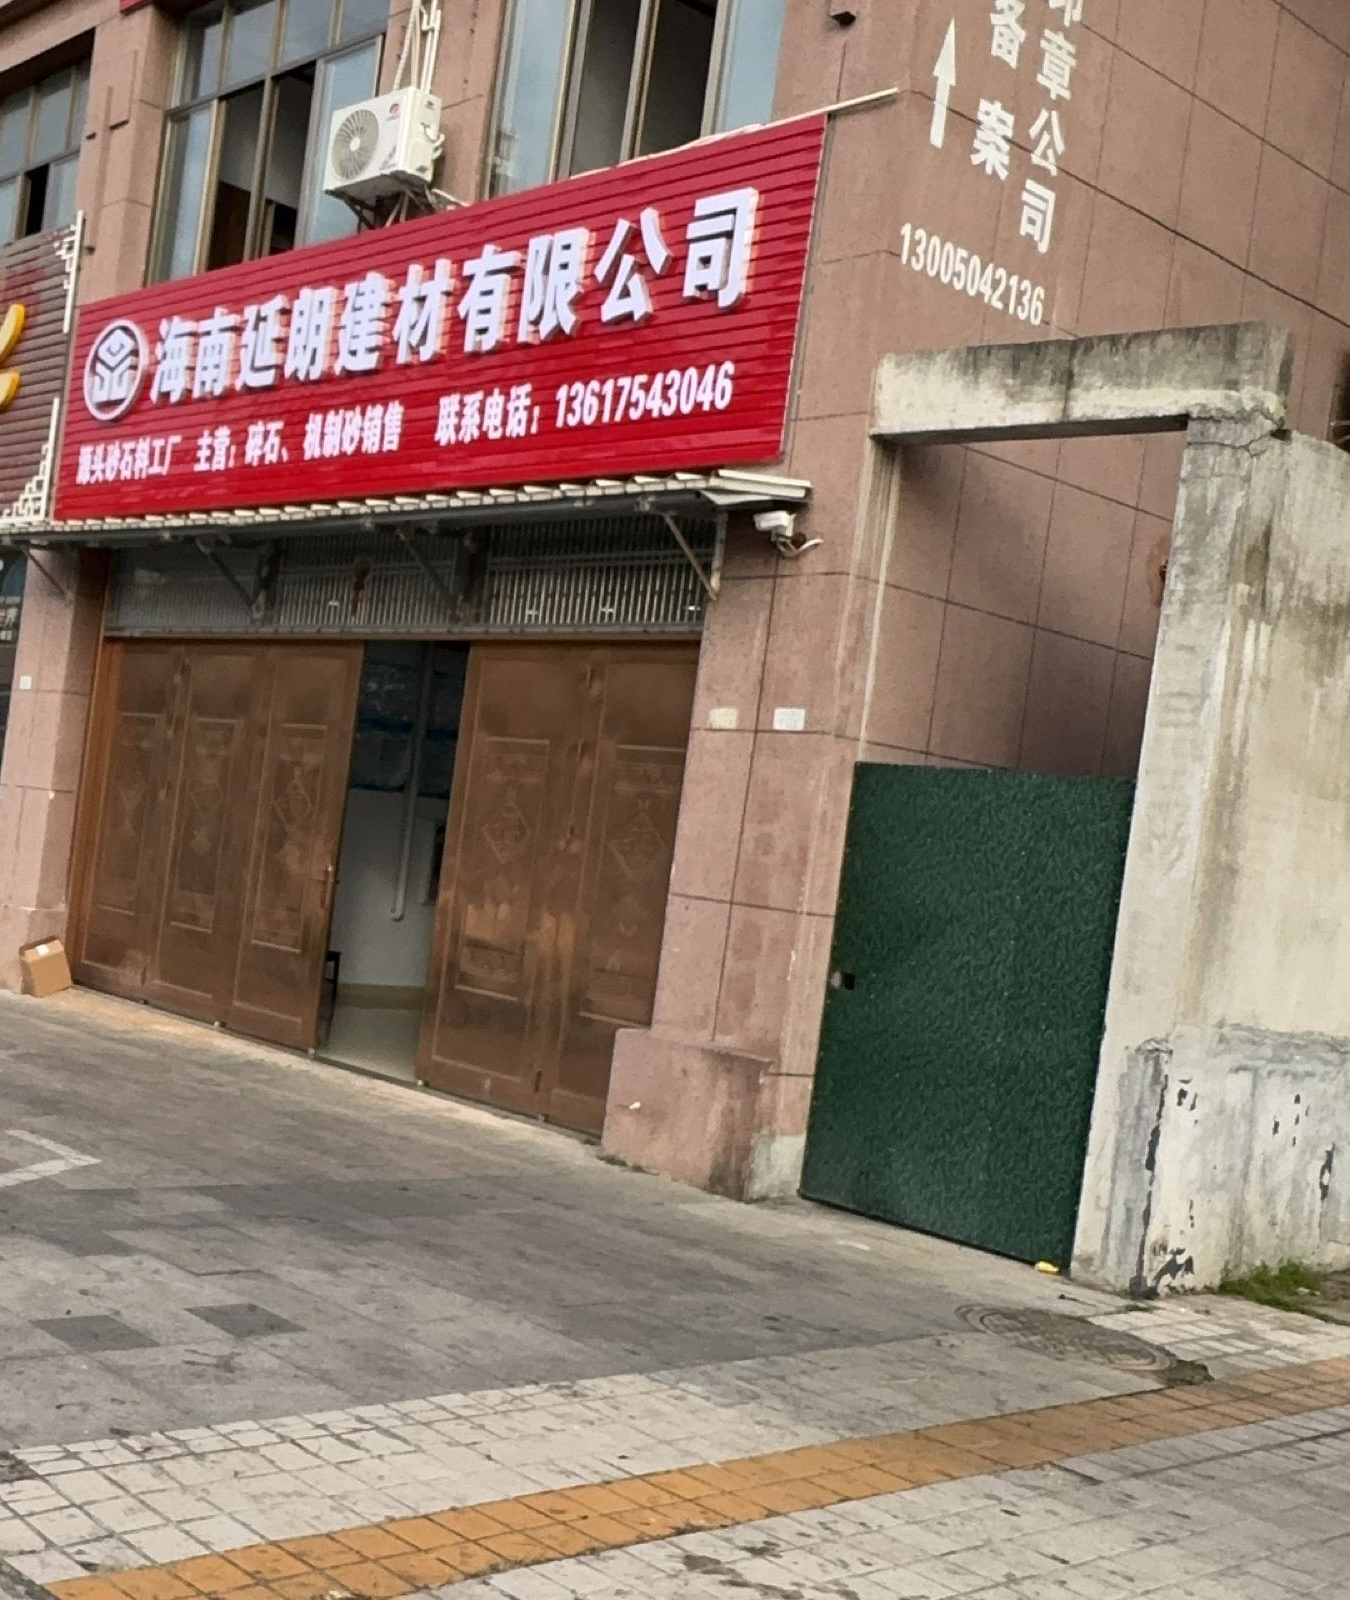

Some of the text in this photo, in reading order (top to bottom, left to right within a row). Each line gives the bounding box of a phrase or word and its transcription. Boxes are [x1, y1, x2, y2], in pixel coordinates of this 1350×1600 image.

[150, 186, 762, 405] 海南延朗建材有限公司
[899, 222, 1046, 327] 13005042136
